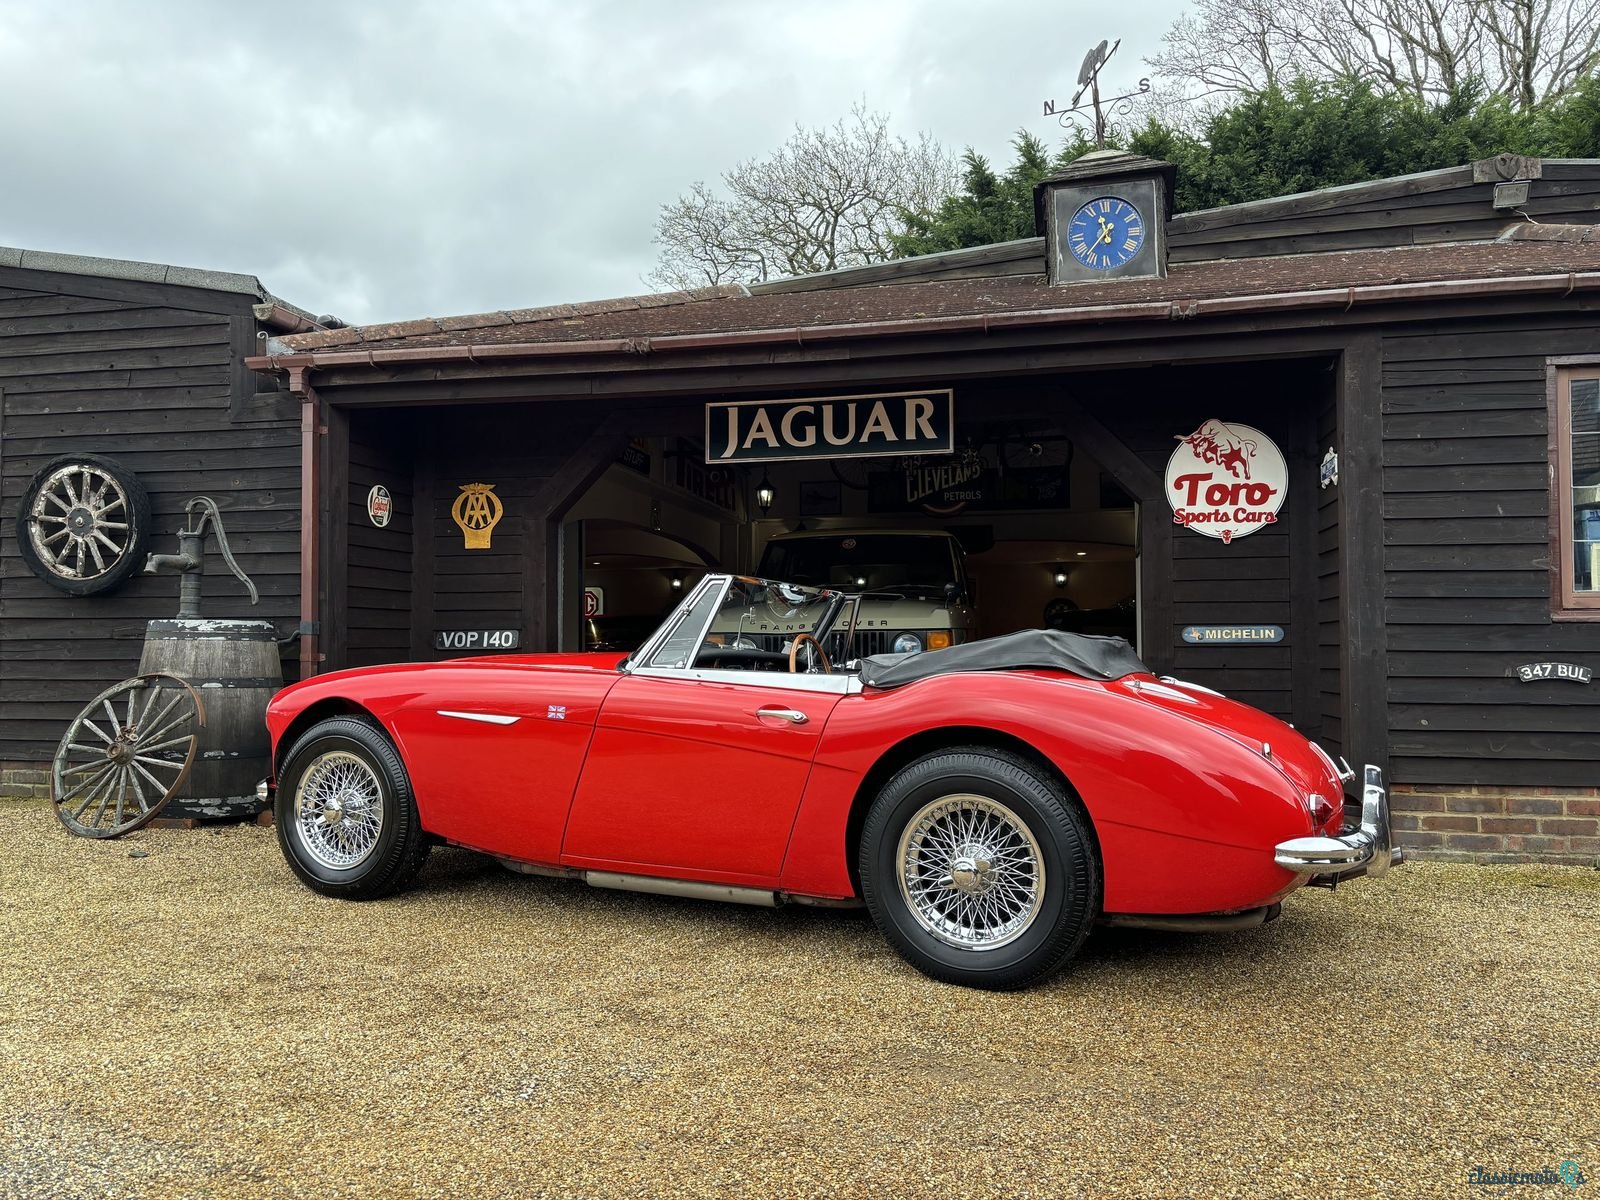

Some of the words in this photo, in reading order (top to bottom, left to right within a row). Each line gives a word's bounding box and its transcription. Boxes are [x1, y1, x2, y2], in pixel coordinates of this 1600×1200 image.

[1139, 78, 1150, 92] S
[1043, 99, 1055, 115] N
[720, 397, 939, 458] JAGUAR
[906, 464, 980, 502] CLEVELAND
[1173, 472, 1278, 506] Toro
[944, 490, 982, 501] PETROLS
[1173, 508, 1232, 527] Sports
[1233, 507, 1277, 523] Cars
[442, 631, 479, 648] VOP
[482, 631, 513, 648] 140
[1205, 629, 1275, 639] MICHELIN
[1520, 664, 1553, 679] 347
[1557, 664, 1588, 681] BUL
